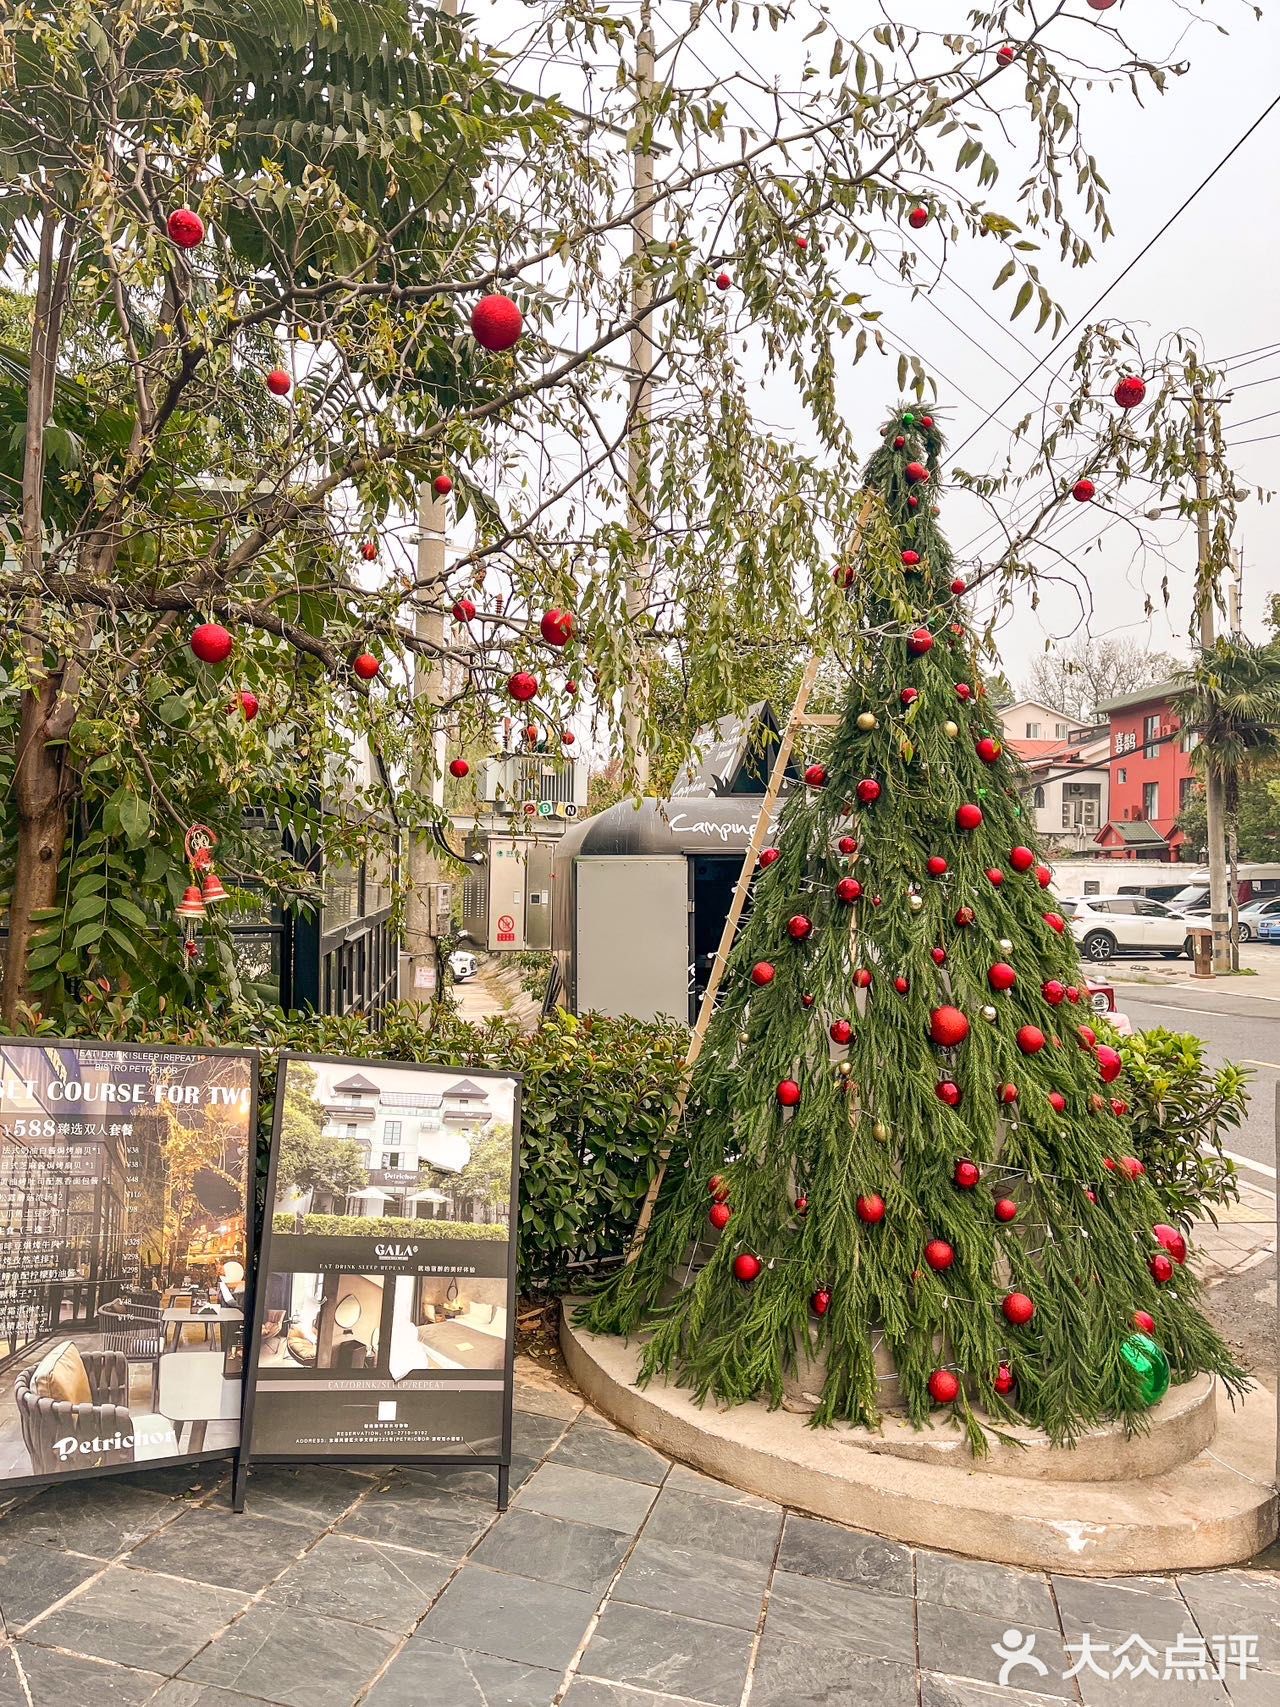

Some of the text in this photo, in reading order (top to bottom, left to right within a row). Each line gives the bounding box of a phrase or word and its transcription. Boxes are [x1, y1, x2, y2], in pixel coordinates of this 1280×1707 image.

[132, 1052, 160, 1060] SLEEP
[164, 1053, 197, 1062] REPEAT
[95, 1064, 127, 1072] BISTRO
[47, 1081, 146, 1103] COURSE
[155, 1085, 200, 1104] FOR
[375, 1244, 413, 1257] GALA
[52, 1430, 176, 1462] Petrichor
